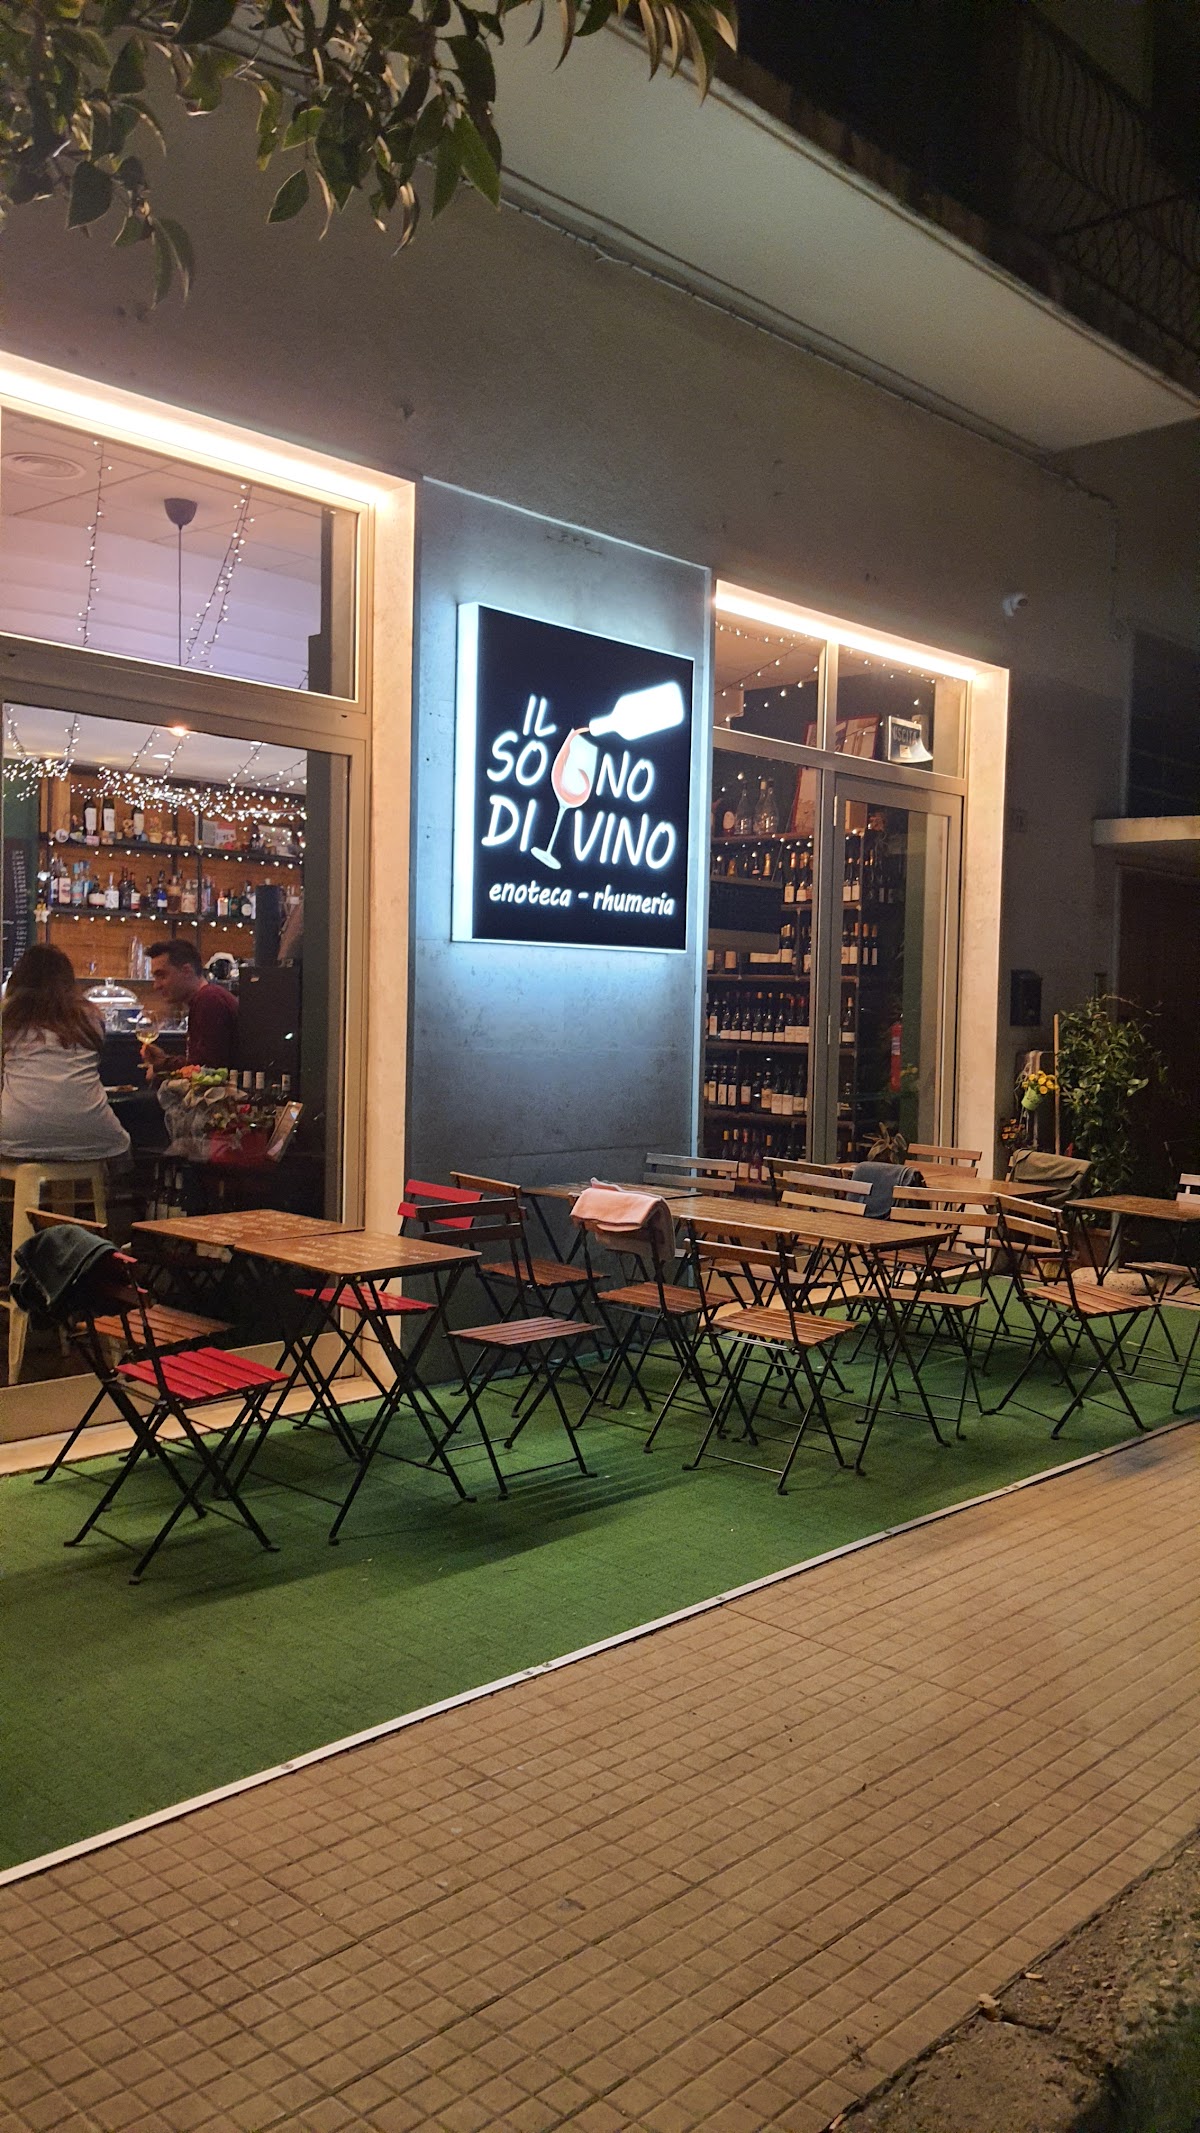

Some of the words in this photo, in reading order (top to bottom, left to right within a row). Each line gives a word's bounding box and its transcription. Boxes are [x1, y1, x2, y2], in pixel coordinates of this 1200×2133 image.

[522, 694, 557, 738] IL
[488, 880, 573, 908] enoteca
[592, 884, 675, 917] rhumeria
